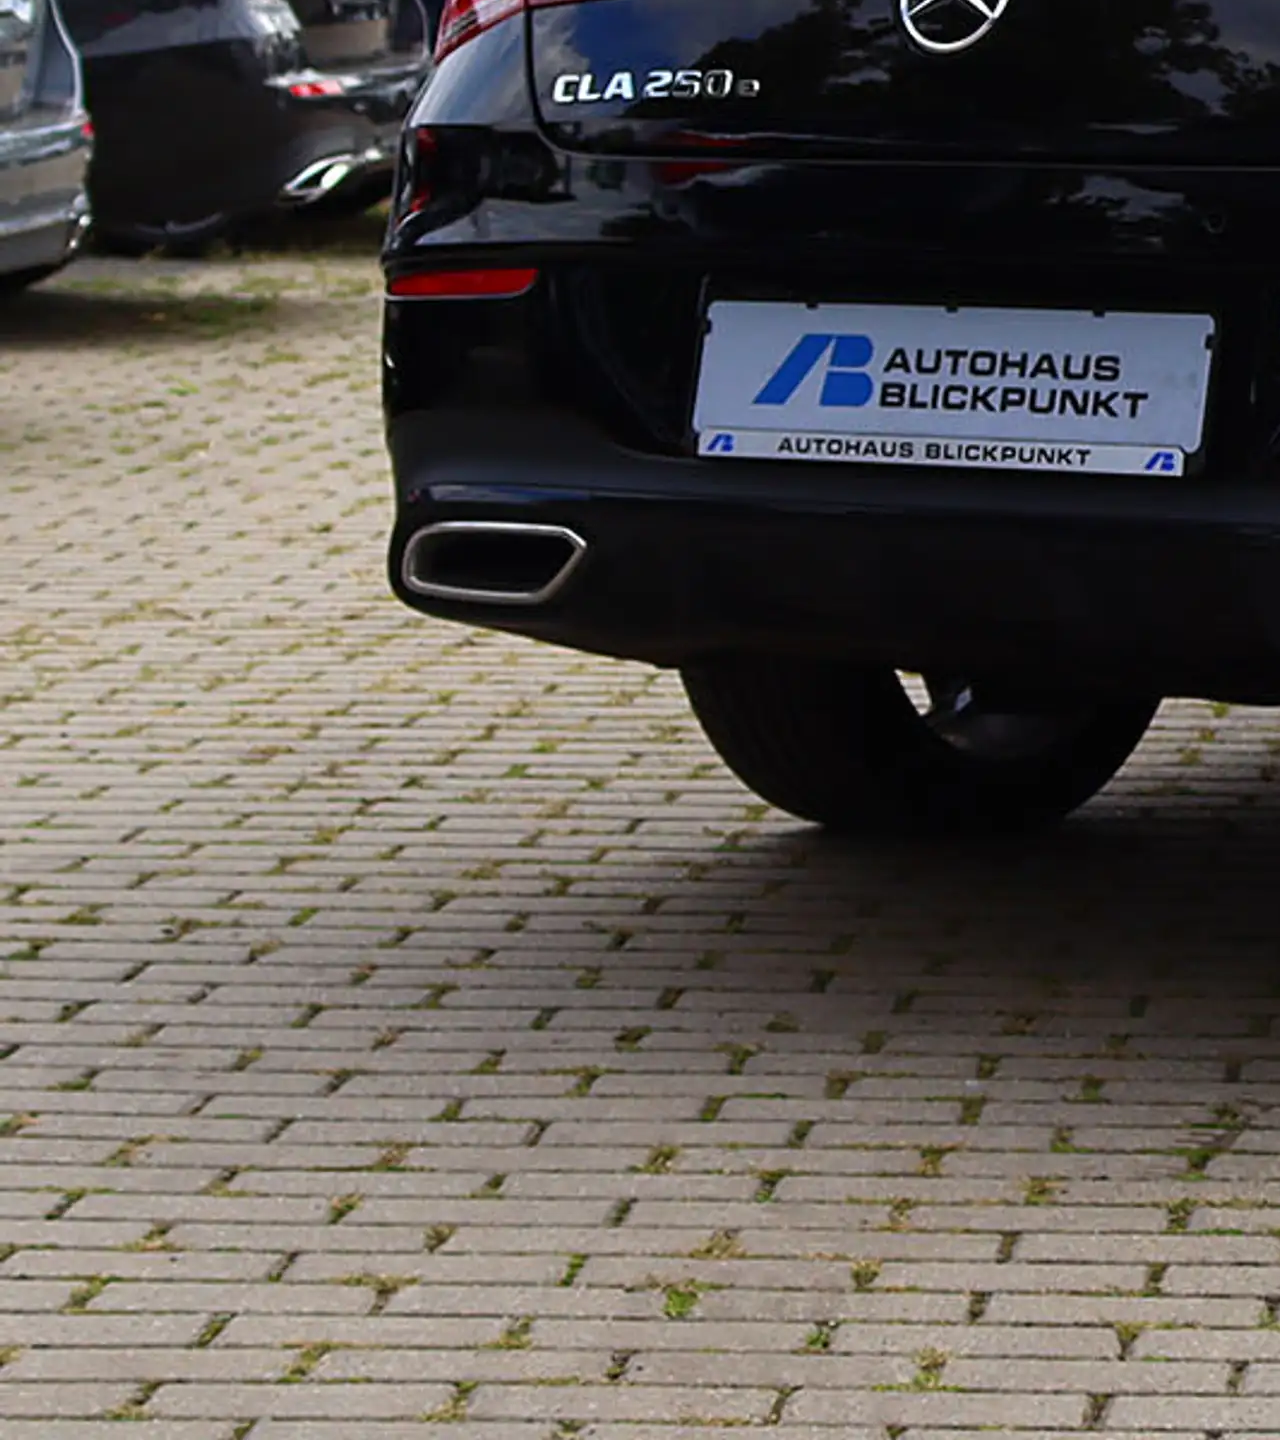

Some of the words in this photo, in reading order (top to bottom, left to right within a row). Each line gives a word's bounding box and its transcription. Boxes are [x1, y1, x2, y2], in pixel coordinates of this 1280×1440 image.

[552, 70, 635, 103] CLA
[883, 347, 1121, 382] AUTOHAUS
[878, 382, 1149, 419] BLICKPUNKT
[777, 437, 914, 459] AUTOHAUS
[924, 443, 1091, 467] BLICKPUNKT
